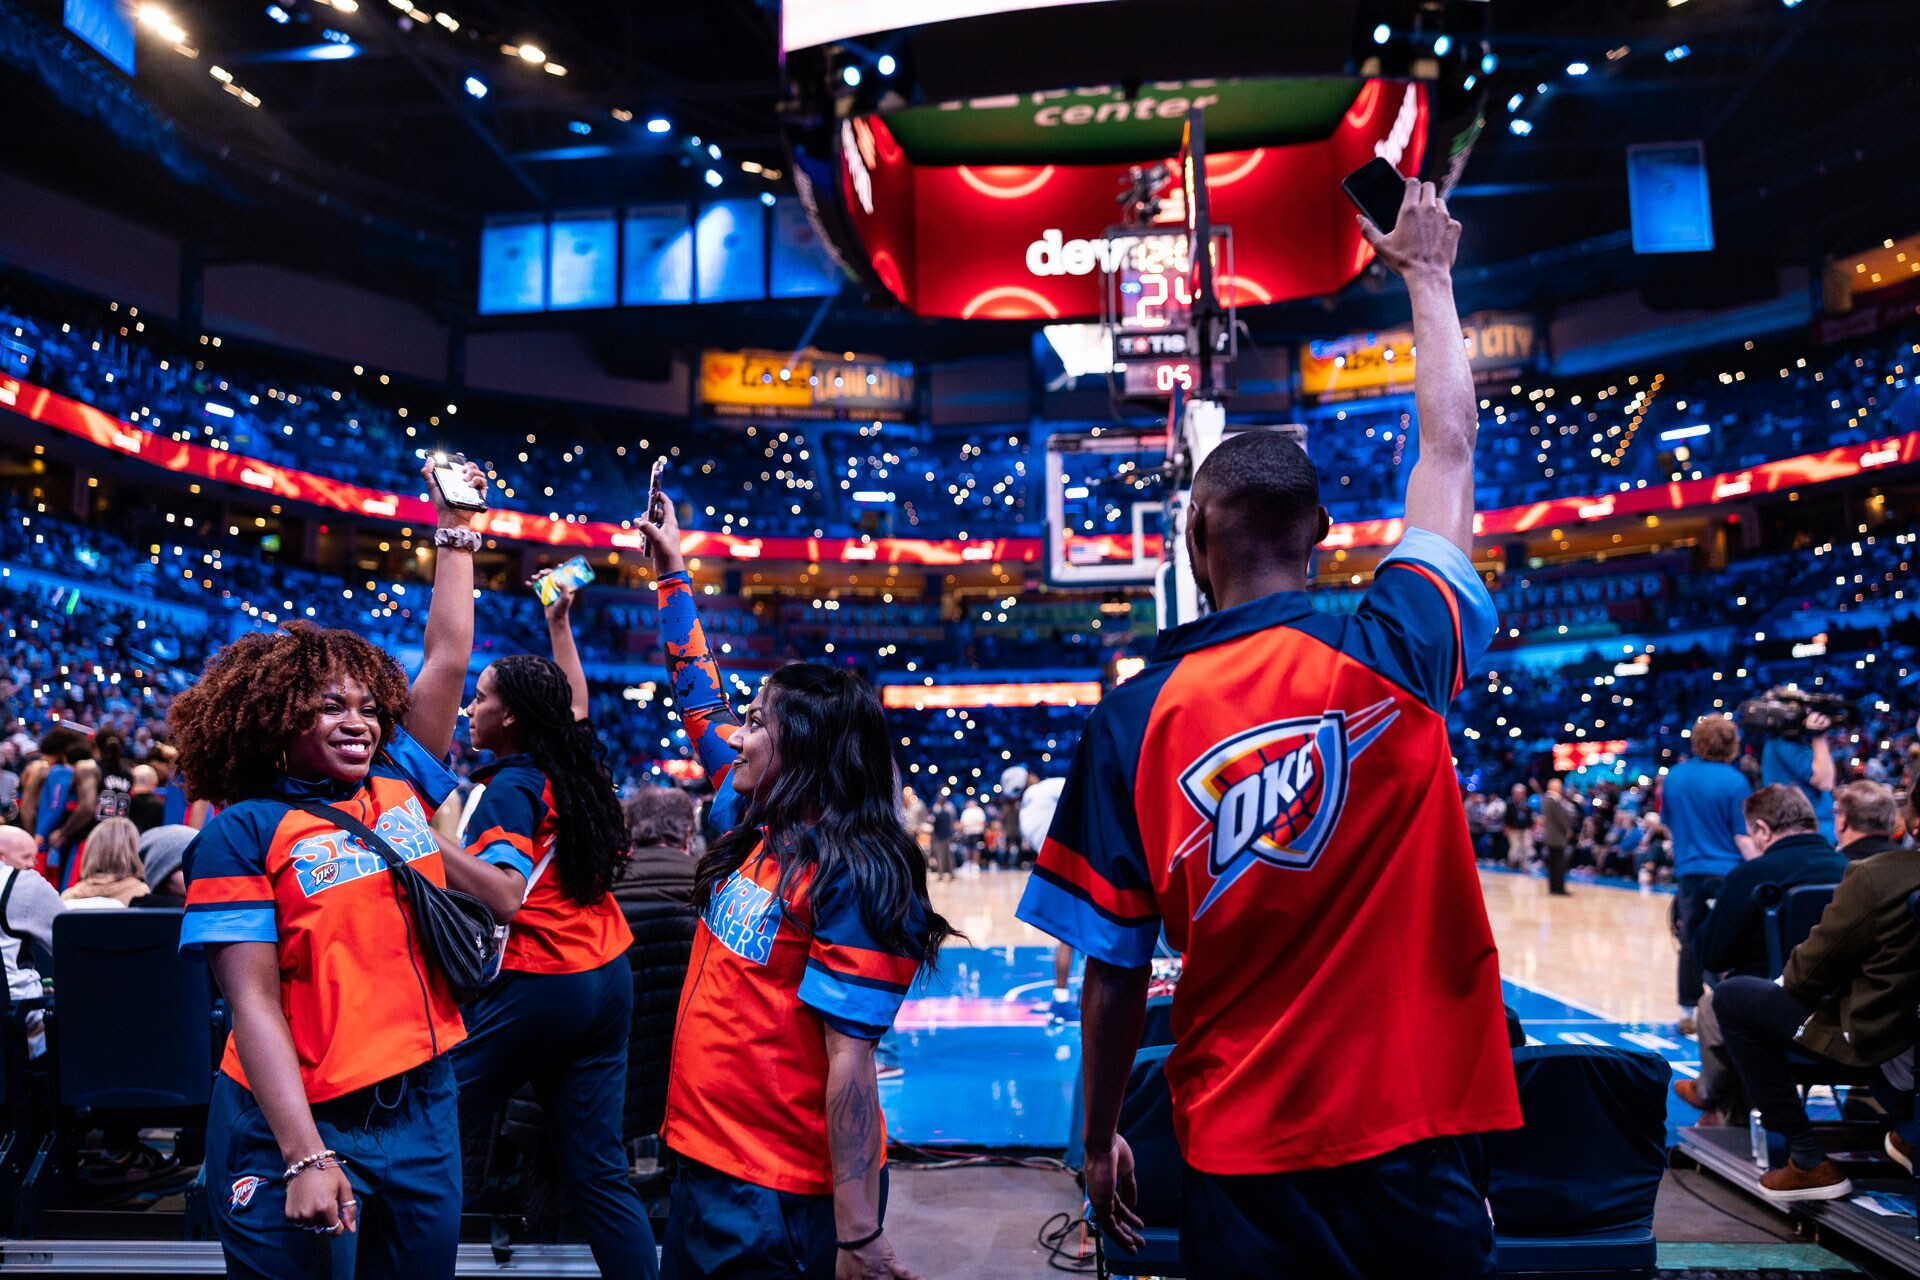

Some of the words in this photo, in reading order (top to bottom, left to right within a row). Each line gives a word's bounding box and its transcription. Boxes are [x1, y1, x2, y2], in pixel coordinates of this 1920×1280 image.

[1034, 94, 1218, 127] center
[1214, 738, 1315, 867] OKC
[314, 862, 336, 887] OKC
